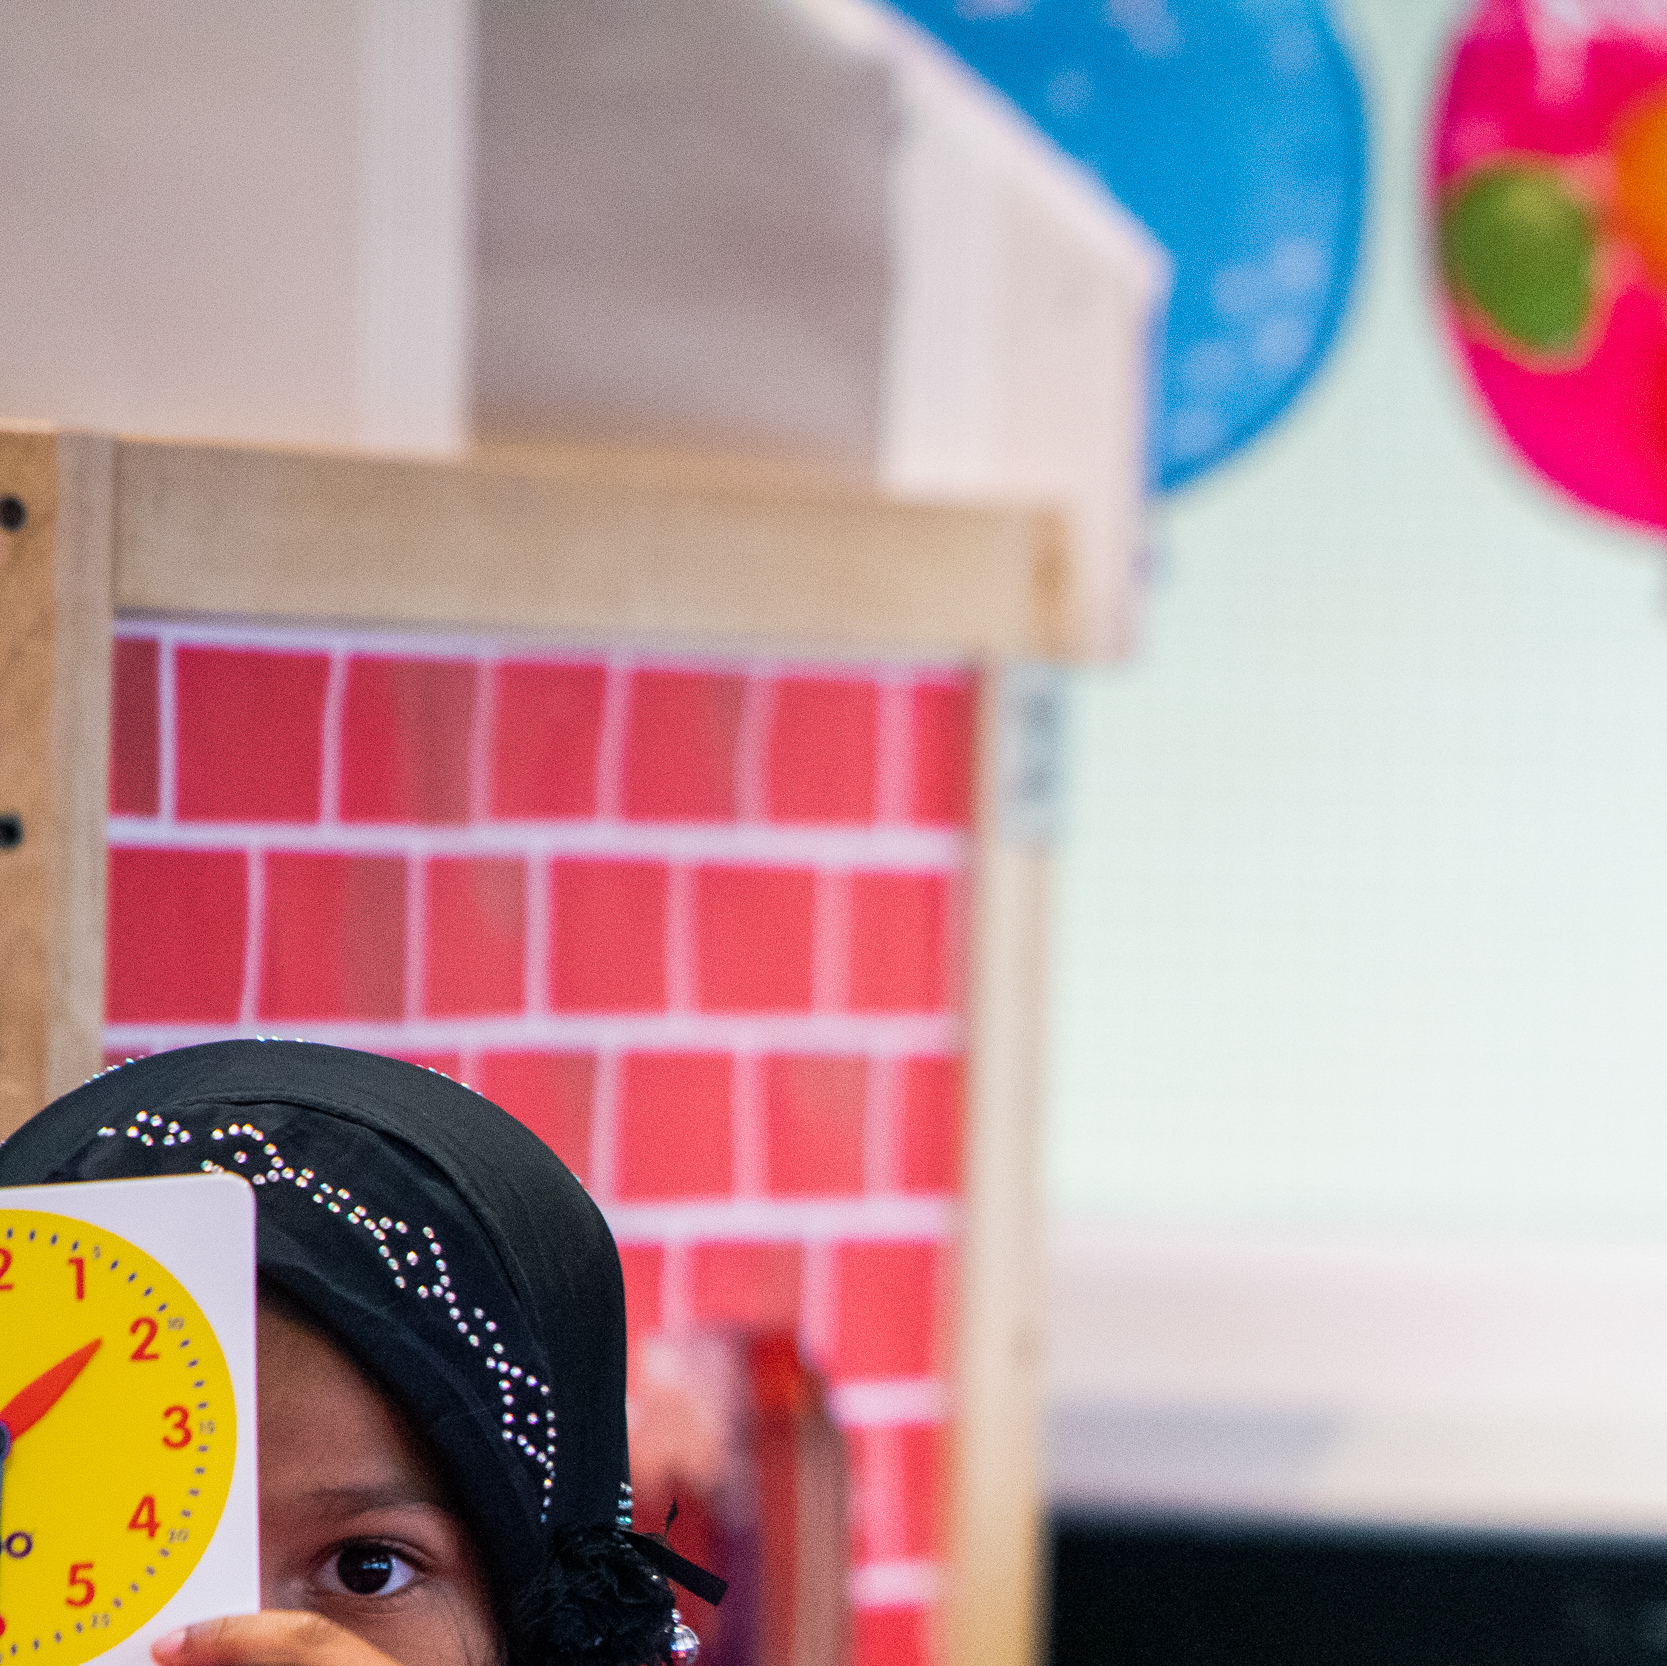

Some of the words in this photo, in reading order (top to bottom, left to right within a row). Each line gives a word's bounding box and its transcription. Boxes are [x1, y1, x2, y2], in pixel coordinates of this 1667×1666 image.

[68, 1257, 85, 1301] 1
[129, 1317, 160, 1362] 2
[162, 1405, 193, 1450] 3
[128, 1495, 161, 1539] 4
[66, 1562, 96, 1608] 5
